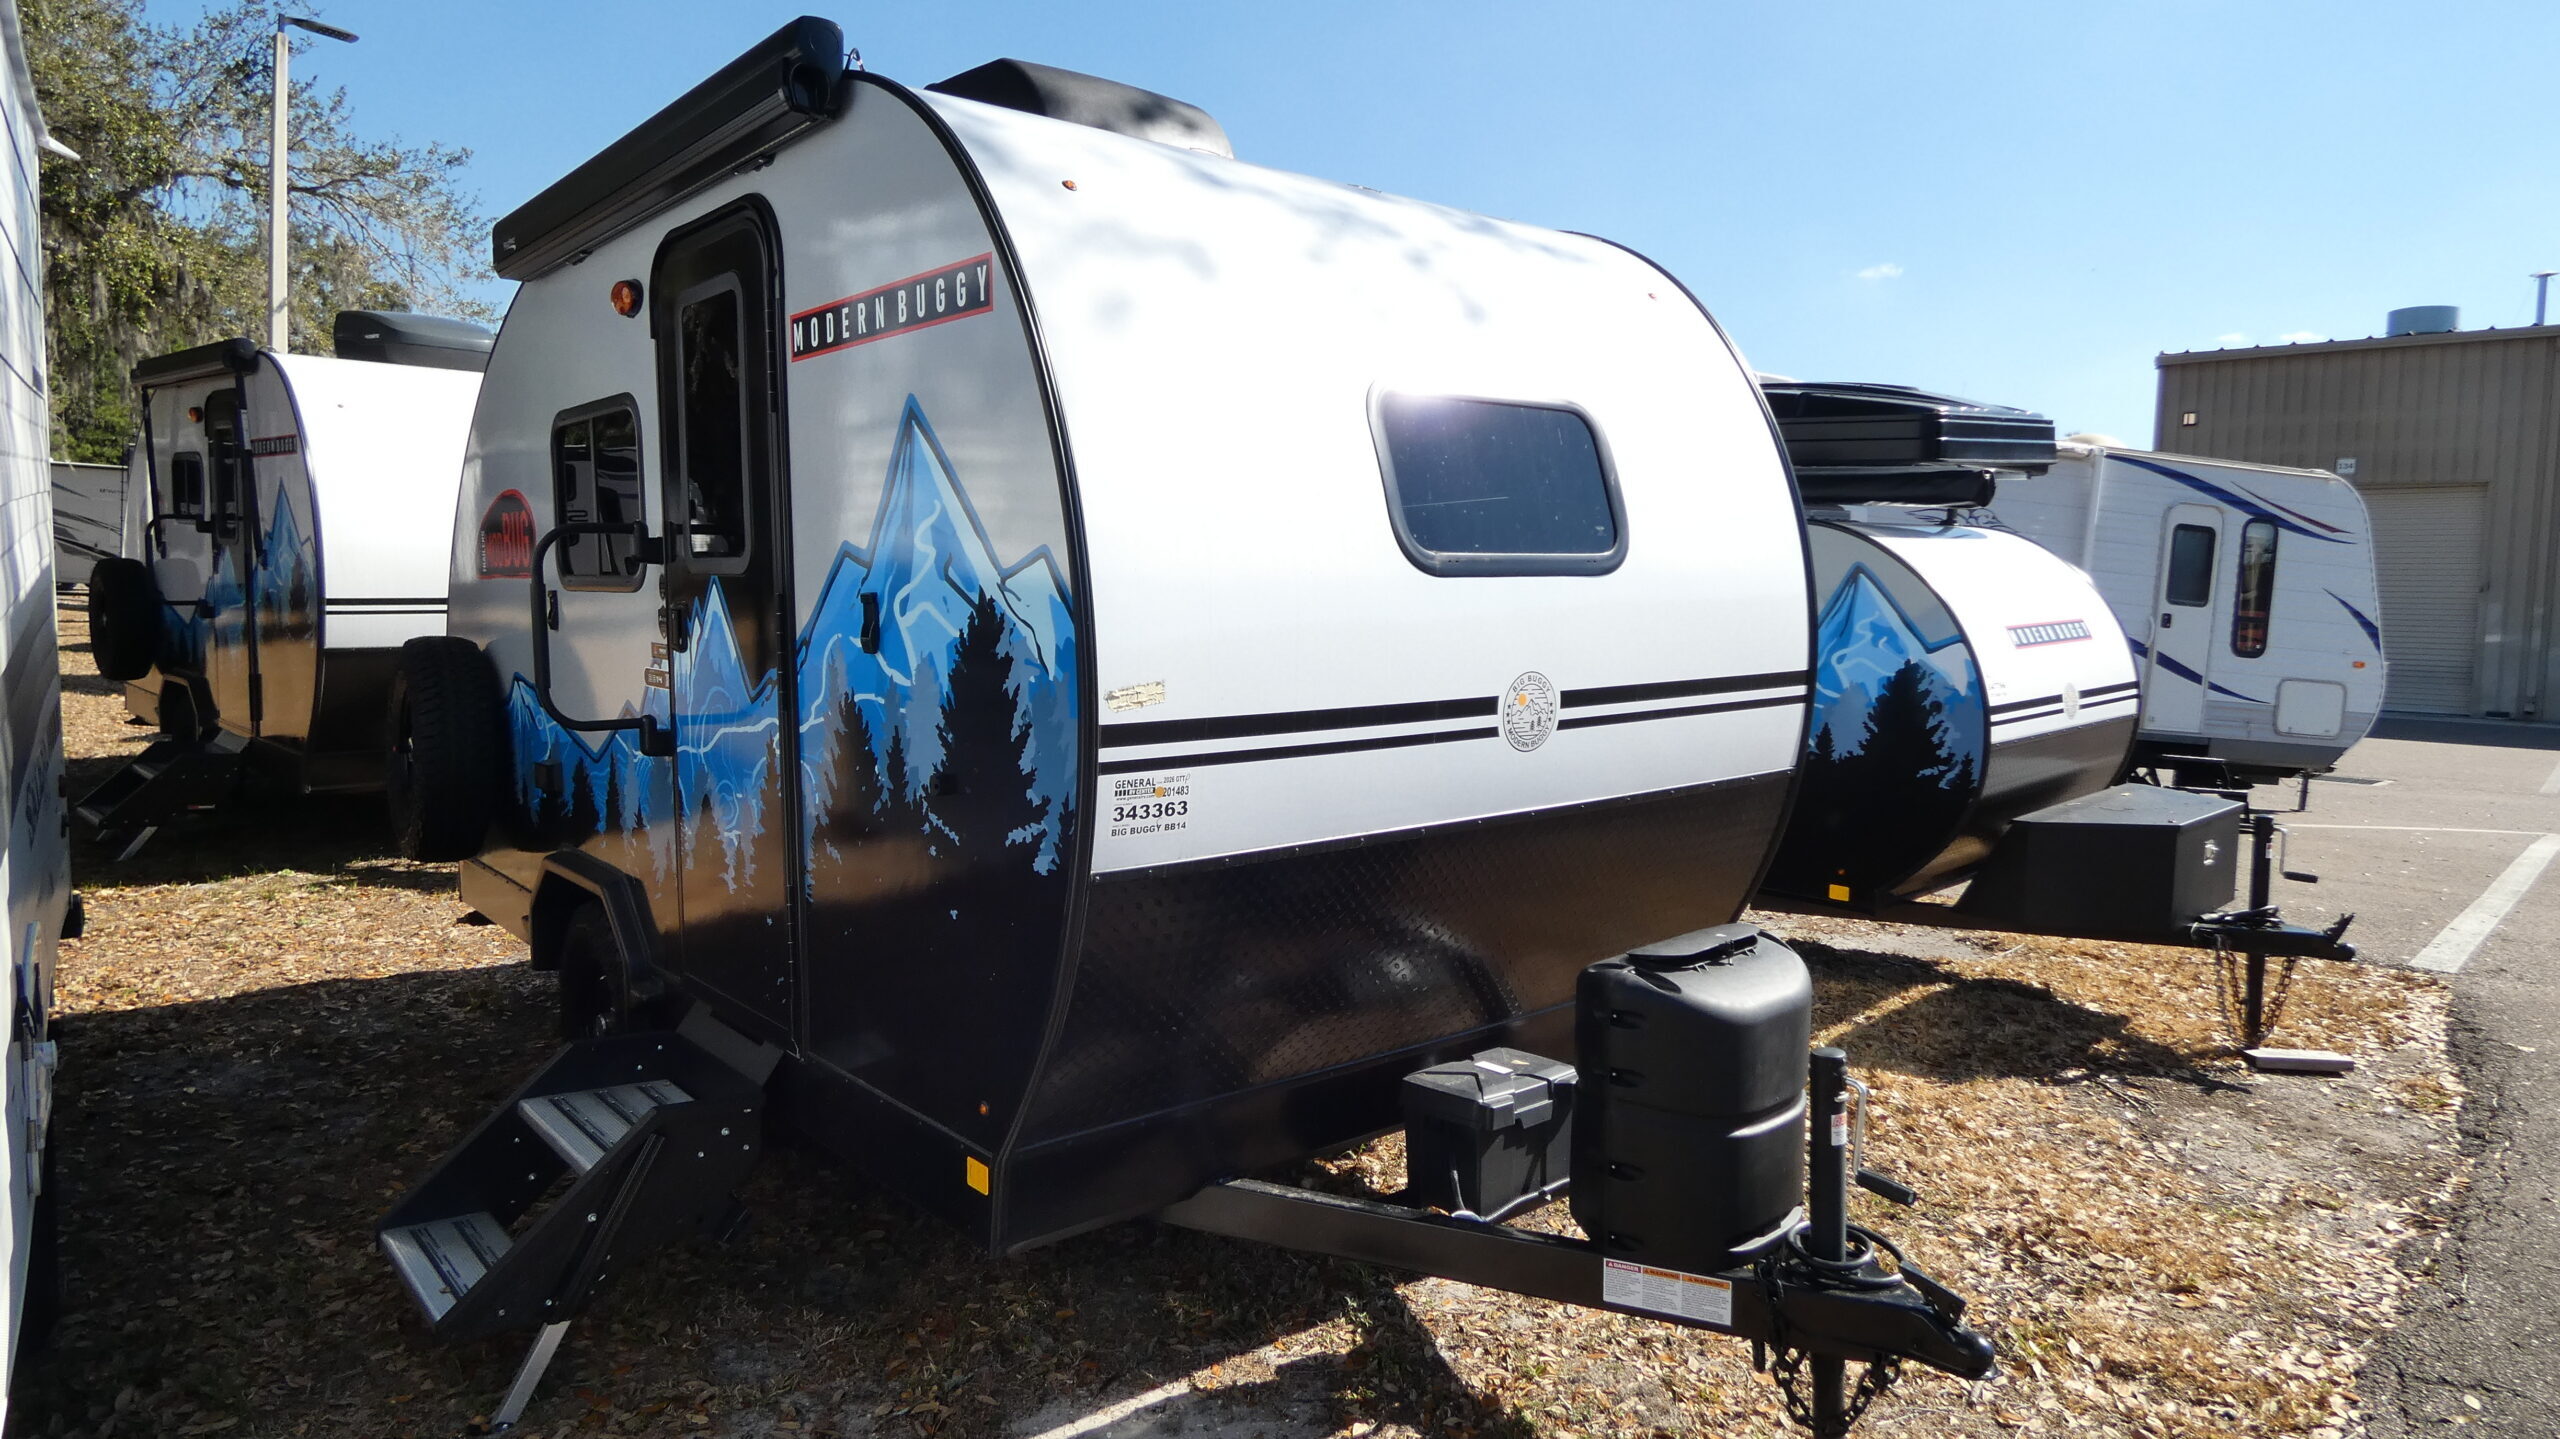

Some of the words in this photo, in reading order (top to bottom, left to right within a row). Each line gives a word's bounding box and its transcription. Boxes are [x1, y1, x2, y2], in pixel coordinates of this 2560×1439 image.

[793, 296, 885, 352] MODERN
[898, 265, 988, 324] BUGGY
[1512, 678, 1525, 693] BIG
[1527, 675, 1551, 692] BUGGY
[1508, 727, 1530, 749] MODERN
[1530, 725, 1550, 748] BUGGY
[1114, 778, 1156, 789] GENERAL
[1112, 800, 1188, 822] 343363
[1111, 828, 1127, 837] BIG
[1130, 823, 1161, 835] BUGGY
[1164, 821, 1186, 831] BB14
[1613, 1262, 1639, 1272] DANGER
[1649, 1269, 1679, 1280] WARNING
[1694, 1277, 1724, 1288] WARNING
